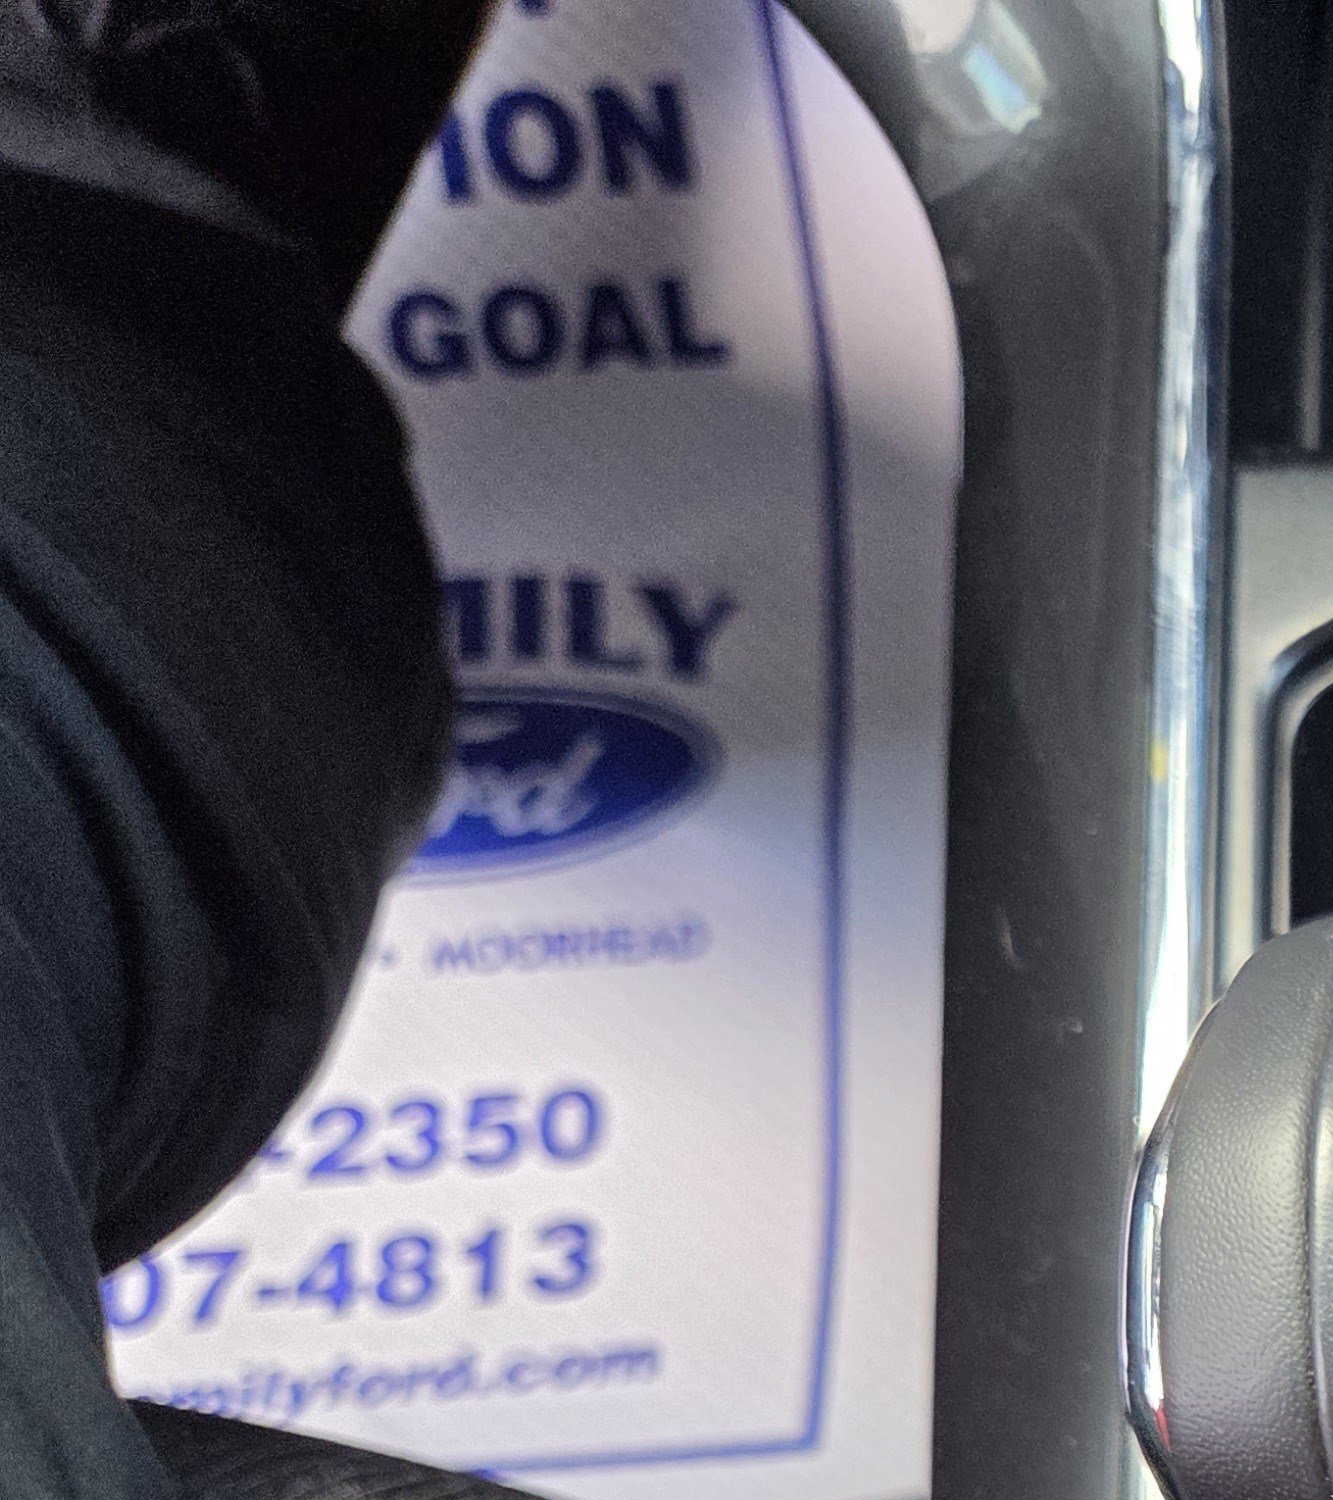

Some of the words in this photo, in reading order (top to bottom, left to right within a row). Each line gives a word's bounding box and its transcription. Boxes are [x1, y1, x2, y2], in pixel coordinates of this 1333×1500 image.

[389, 278, 732, 378] GOAL
[432, 914, 708, 974] MOORHEAD
[264, 1088, 599, 1180] -2350
[103, 1222, 594, 1331] 07-4813
[135, 1347, 662, 1425] milyford.com
